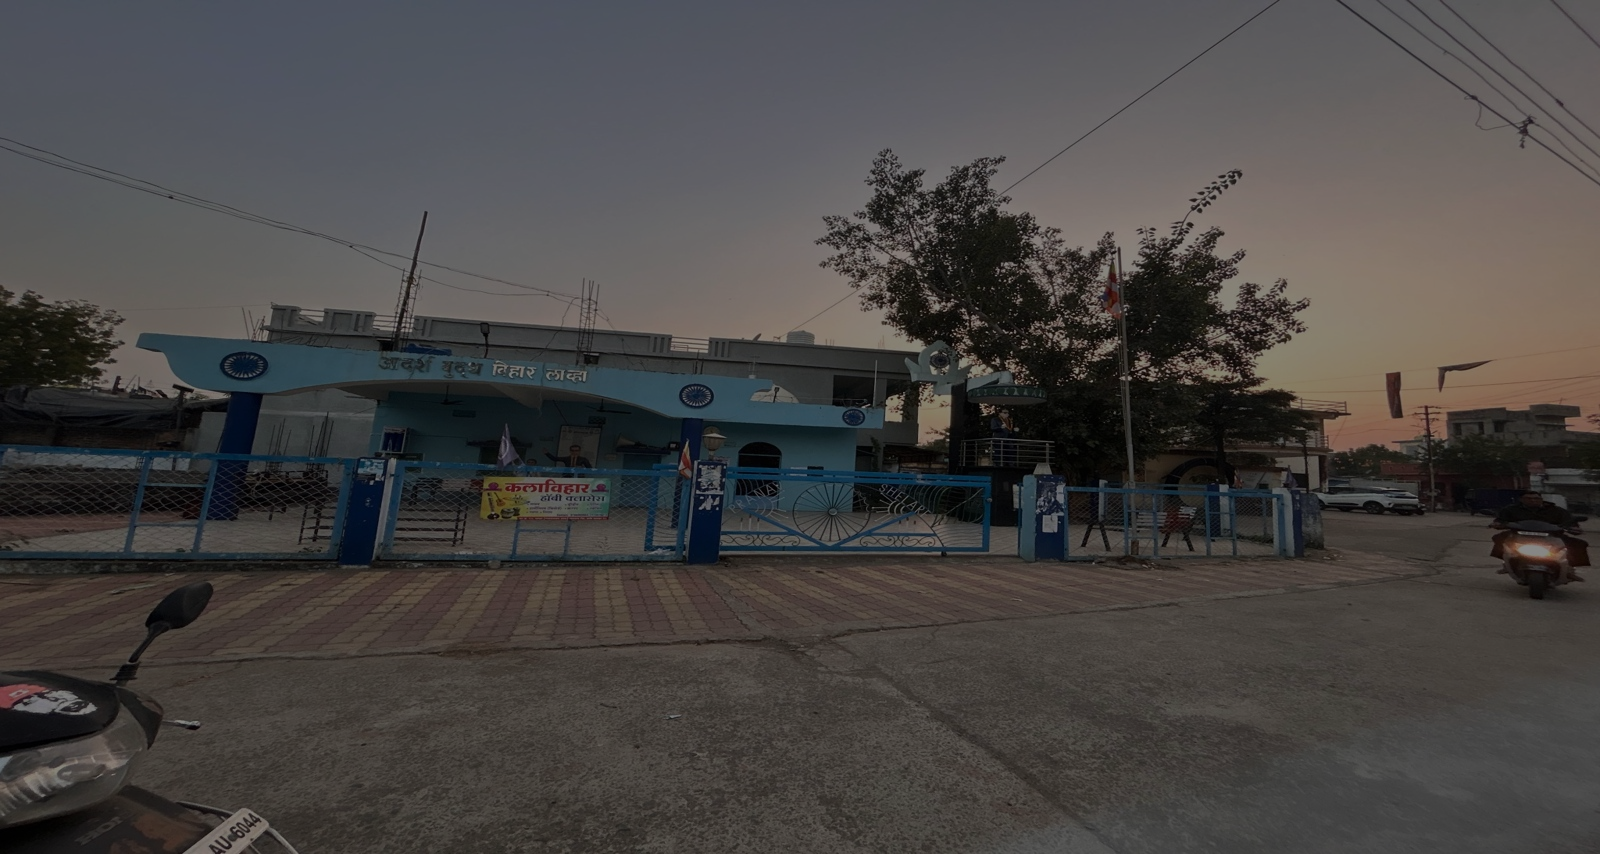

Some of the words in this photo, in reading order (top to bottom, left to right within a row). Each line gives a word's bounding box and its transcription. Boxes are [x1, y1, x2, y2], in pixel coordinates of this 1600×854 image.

[492, 360, 537, 379] विहार
[545, 368, 588, 383] लाव्हा
[505, 479, 590, 495] कलाविहार
